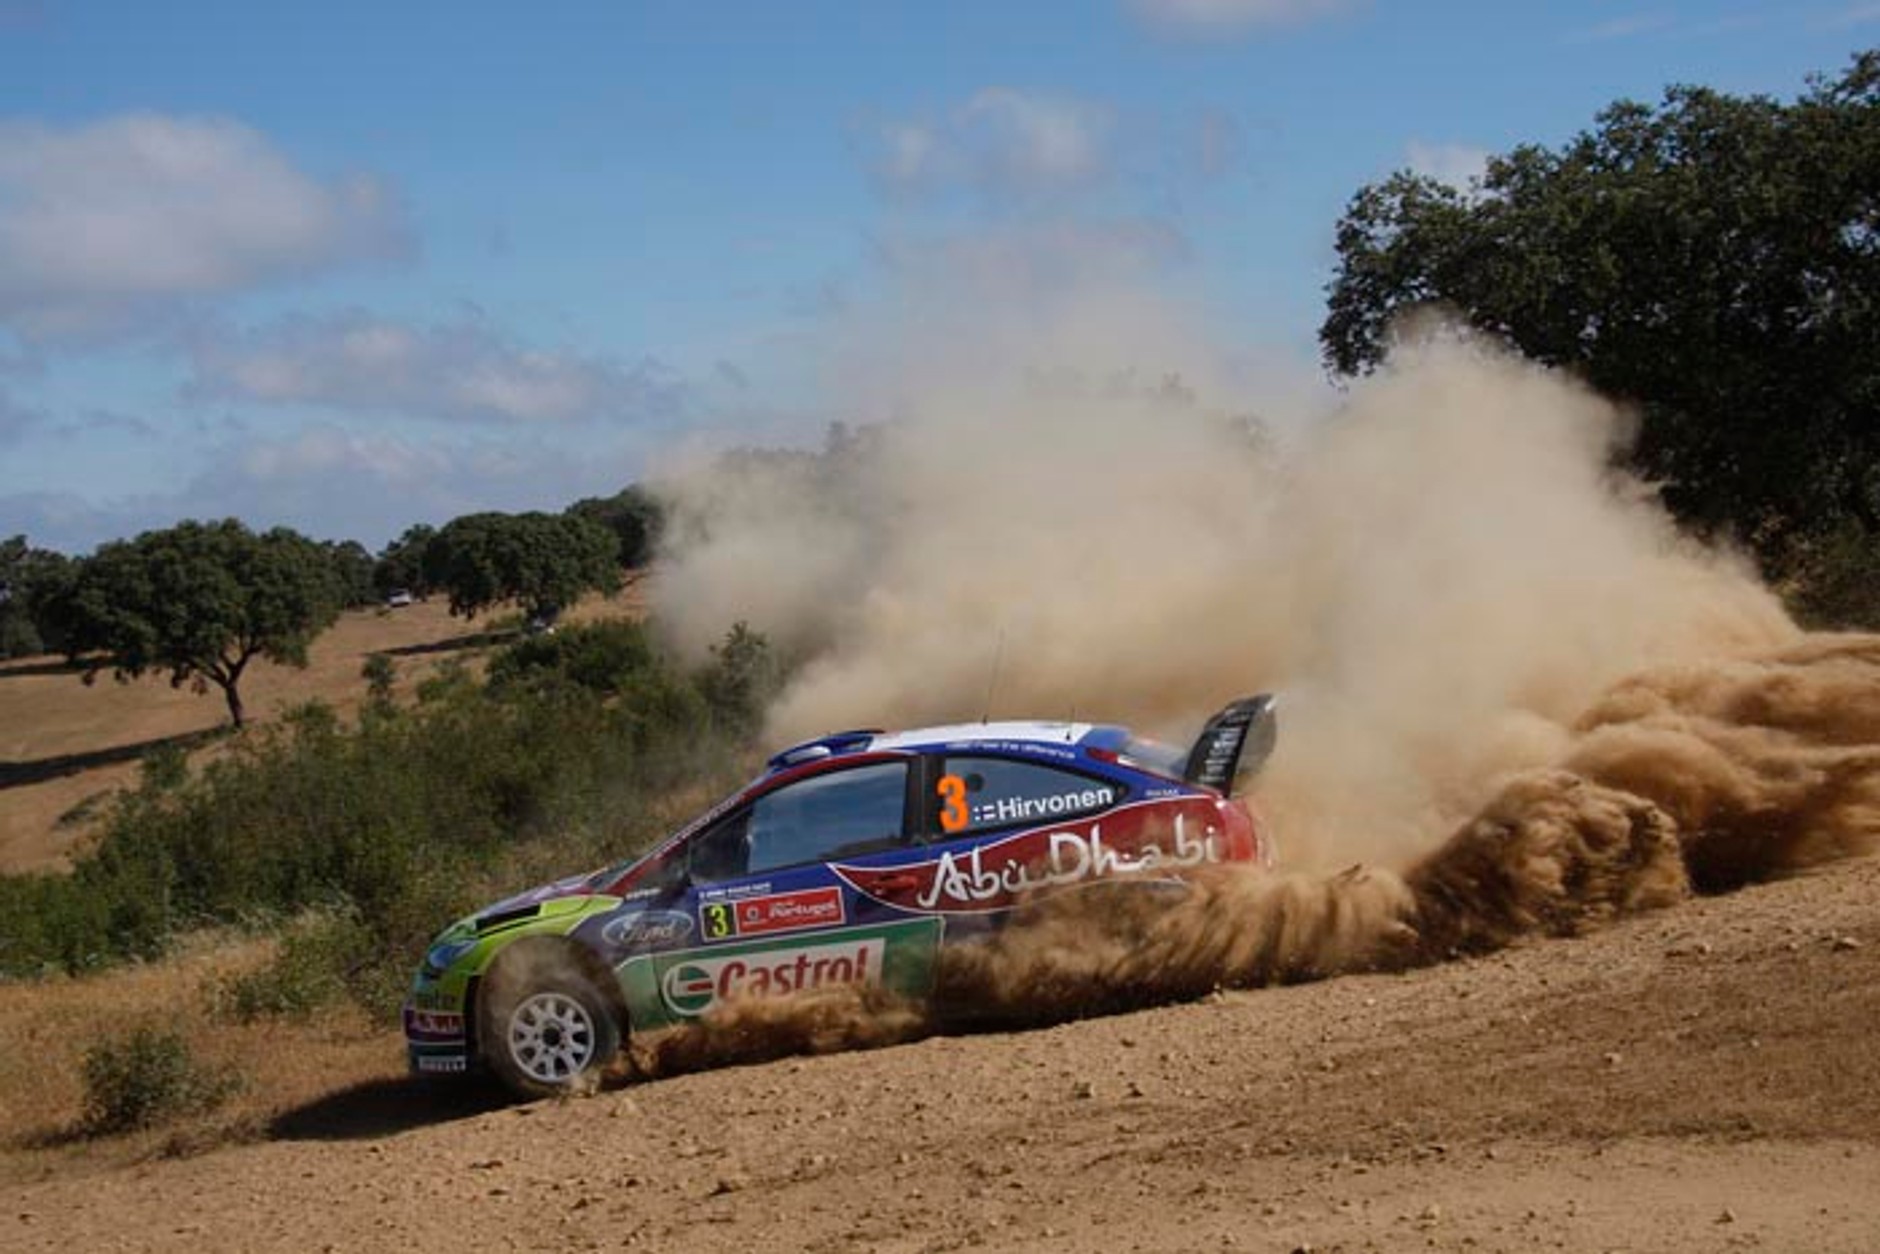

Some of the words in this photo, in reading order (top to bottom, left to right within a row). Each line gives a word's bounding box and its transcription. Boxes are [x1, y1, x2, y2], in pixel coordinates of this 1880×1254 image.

[936, 773, 969, 833] 3
[997, 787, 1114, 822] Hirvonen
[618, 915, 684, 946] Ford
[708, 903, 730, 937] 3
[716, 946, 869, 1002] Castrol
